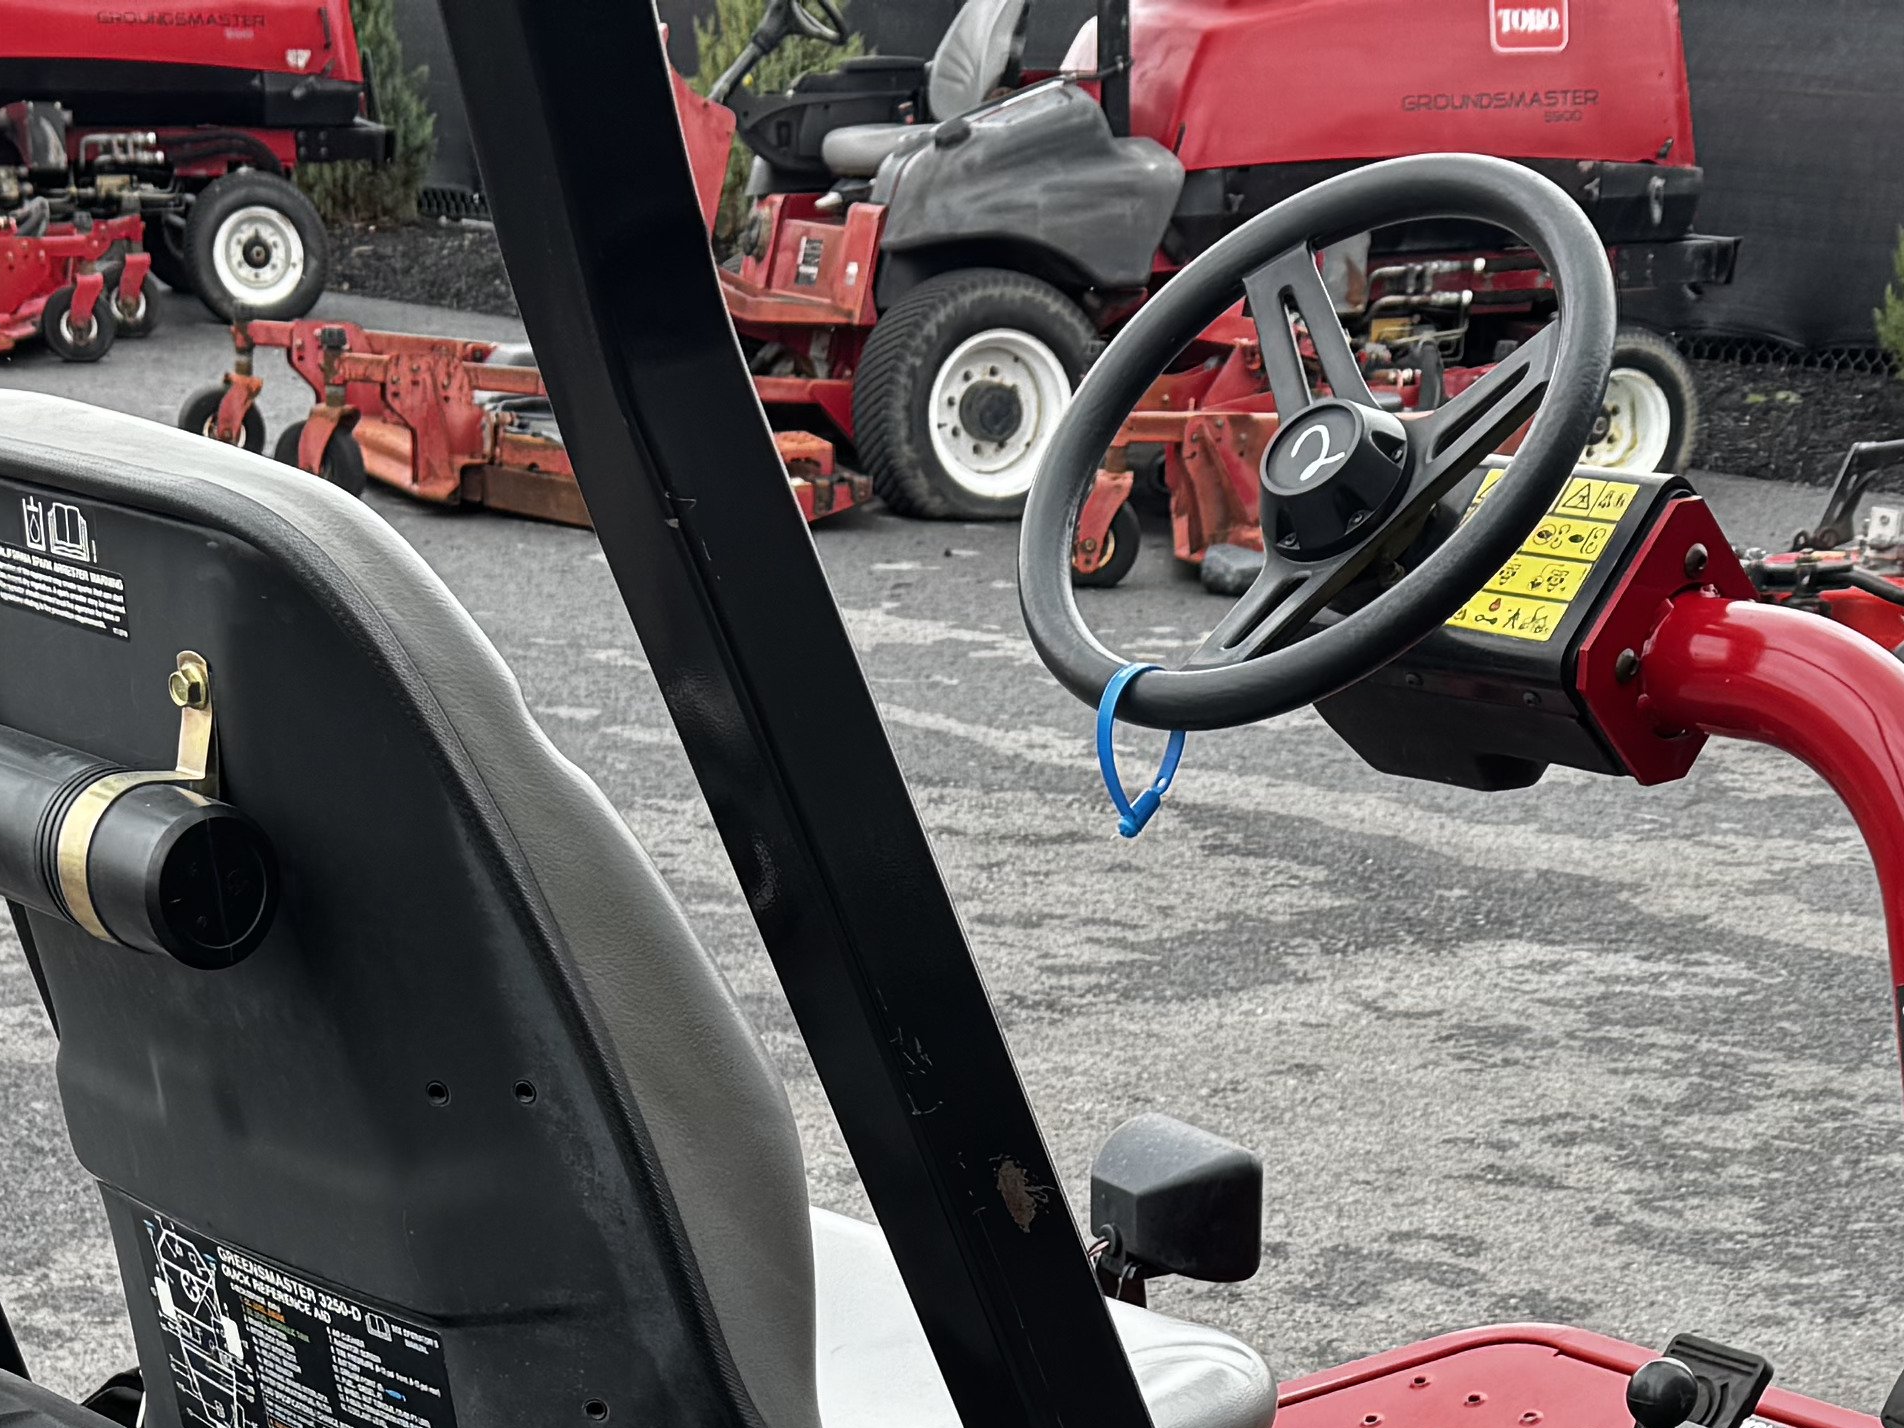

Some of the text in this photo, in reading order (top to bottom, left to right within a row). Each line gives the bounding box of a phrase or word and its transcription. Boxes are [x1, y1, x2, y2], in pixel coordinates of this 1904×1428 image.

[1497, 8, 1560, 33] TORO
[1401, 89, 1600, 112] GROUNDSMASTER
[1290, 424, 1346, 482] 2
[217, 1246, 316, 1303] GREENSMASTER
[318, 1292, 362, 1322] 3250-D
[221, 1263, 252, 1287] QUICK
[252, 1279, 312, 1317] REFERENCE
